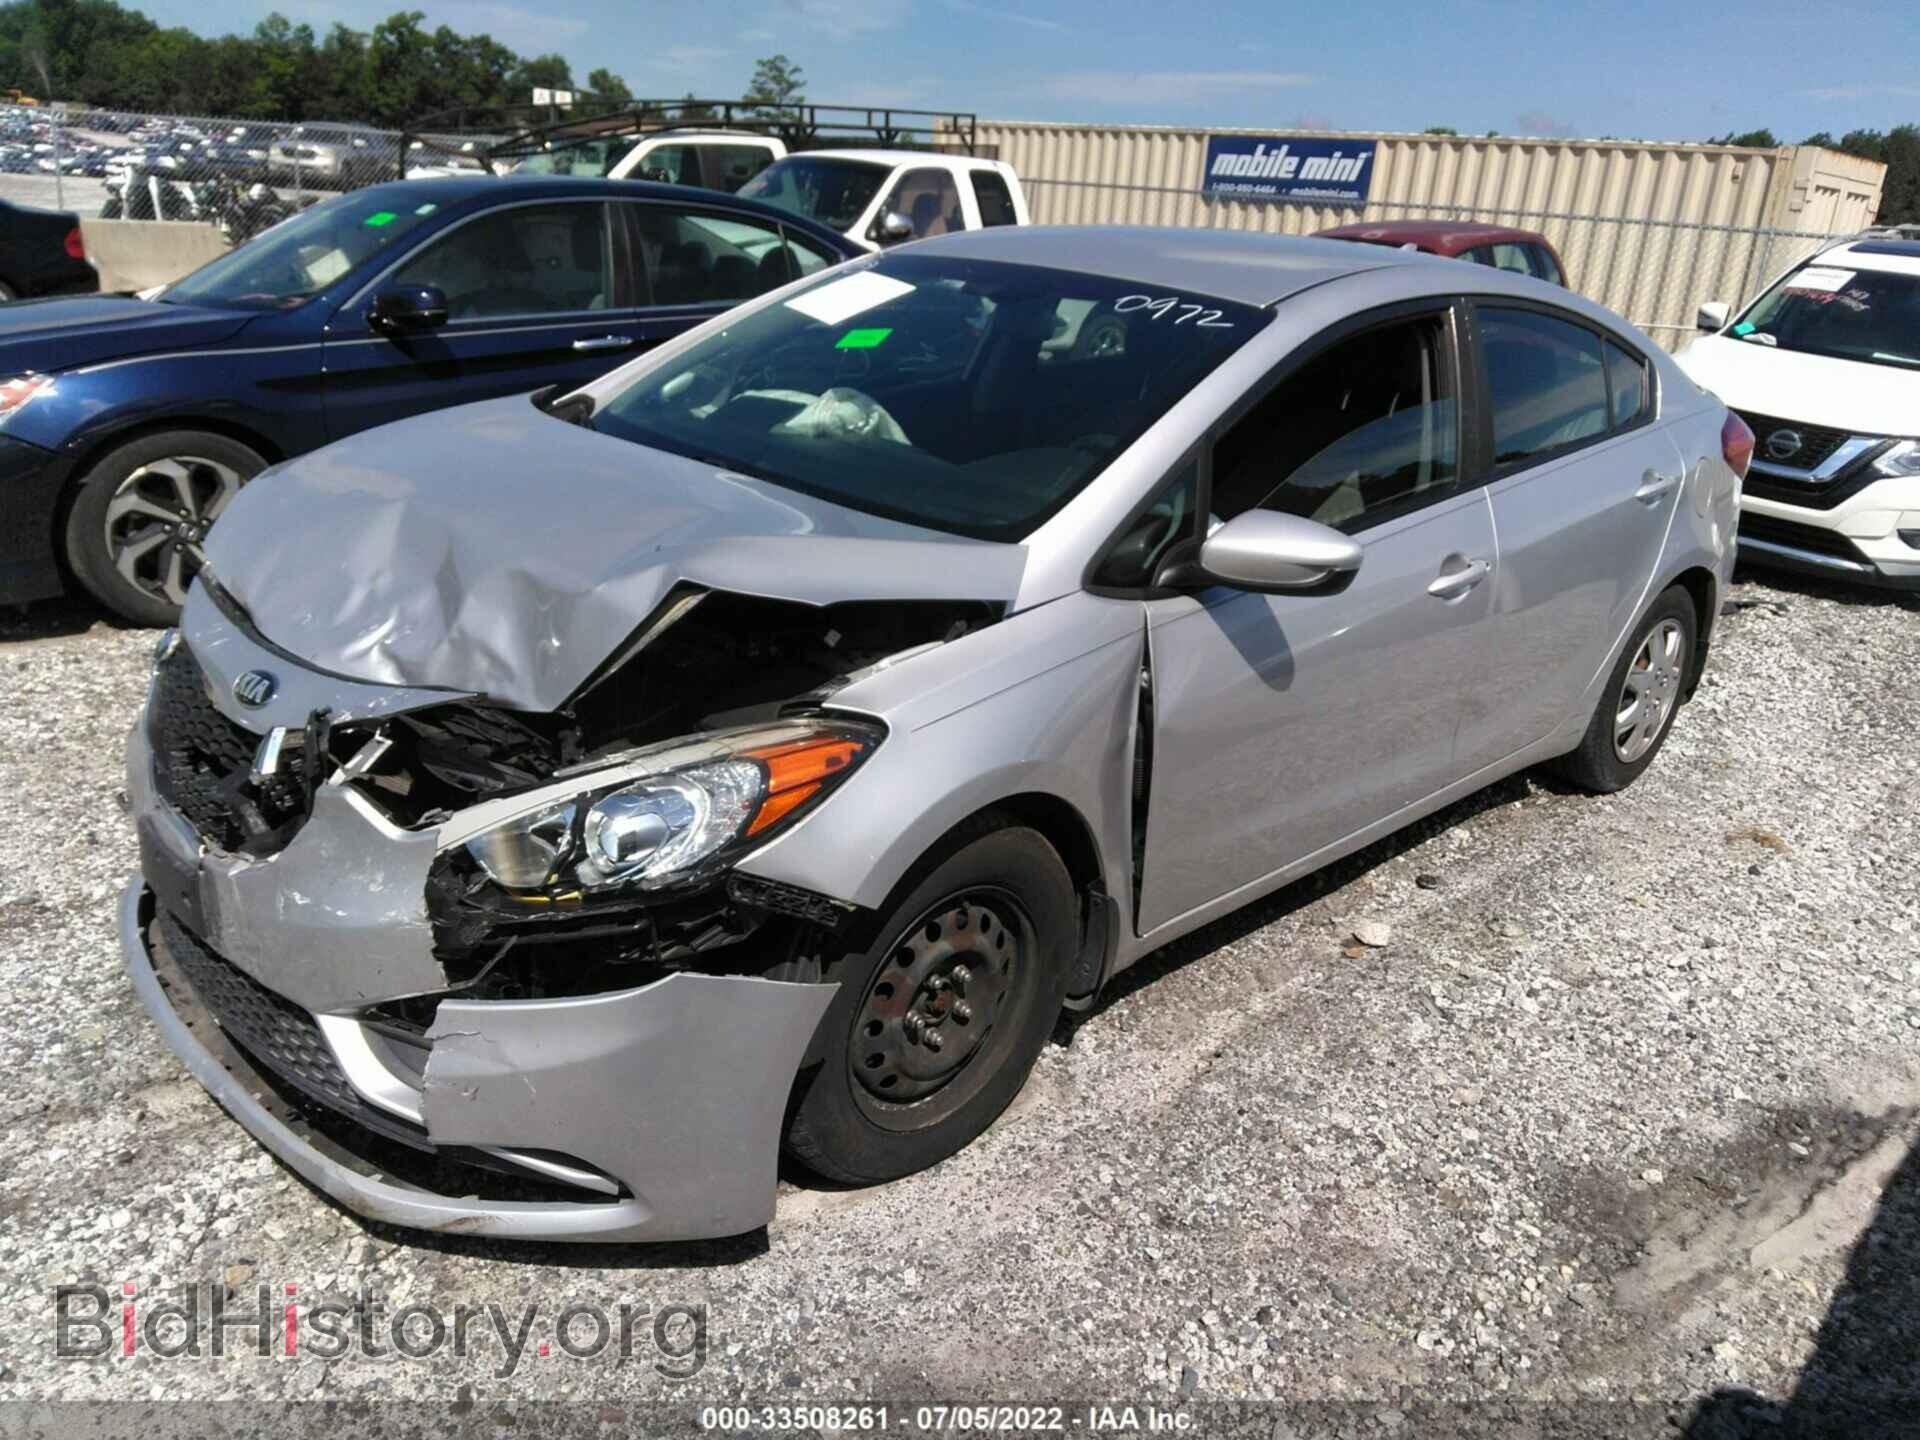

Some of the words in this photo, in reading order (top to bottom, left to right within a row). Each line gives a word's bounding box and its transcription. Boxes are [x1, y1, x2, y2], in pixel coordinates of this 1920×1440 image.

[1210, 143, 1300, 179] mobile
[1299, 151, 1368, 182] mini
[1114, 294, 1235, 327] 0972
